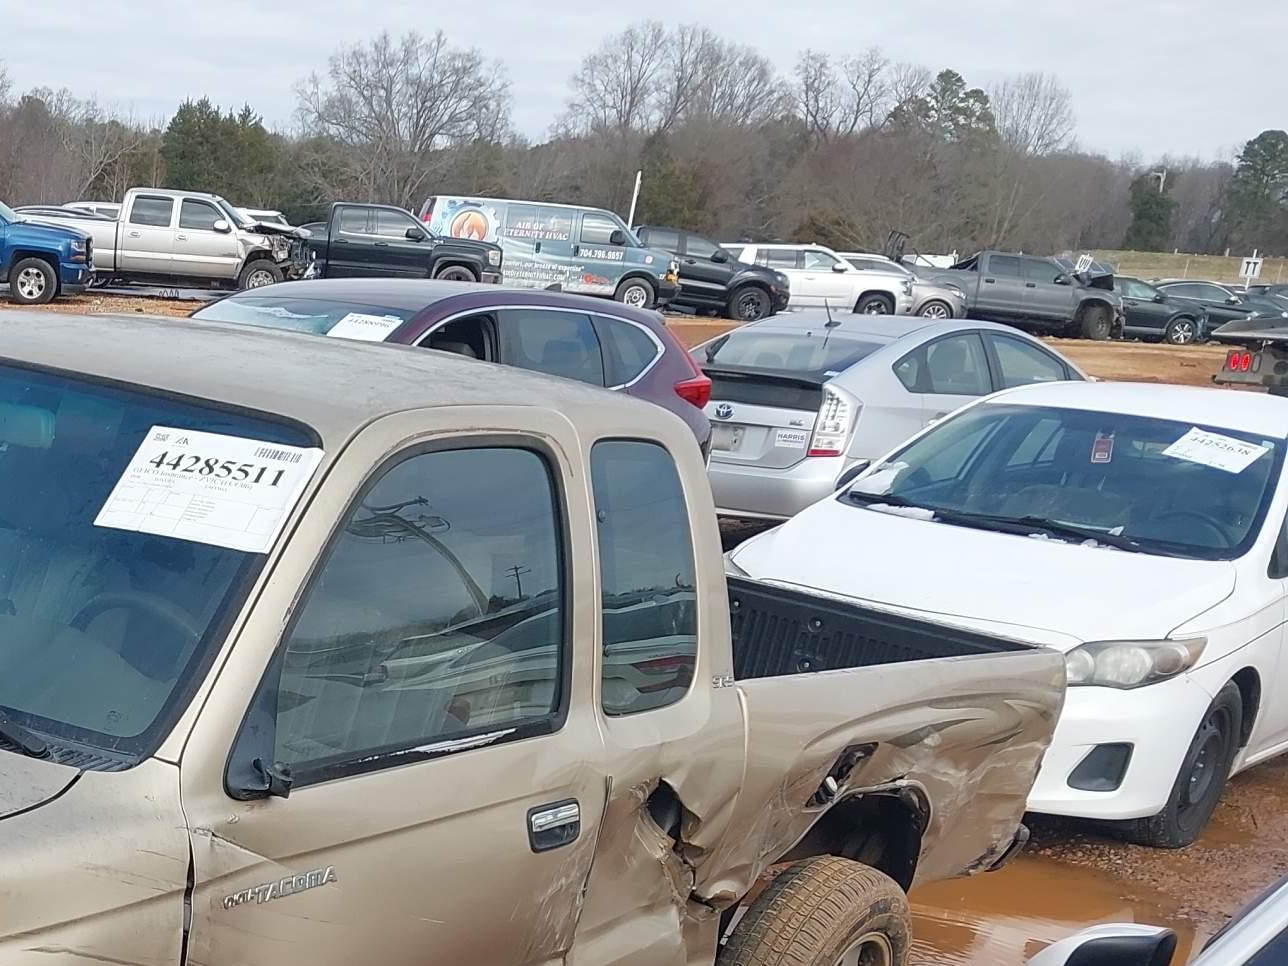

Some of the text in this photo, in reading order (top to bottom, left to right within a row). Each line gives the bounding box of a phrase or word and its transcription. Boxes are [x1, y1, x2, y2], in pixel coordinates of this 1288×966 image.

[516, 221, 531, 229] AIR
[503, 228, 569, 241] ETERNITY HVAC
[1245, 261, 1260, 275] TT
[777, 433, 805, 441] HARRIS
[149, 450, 287, 488] 44285511
